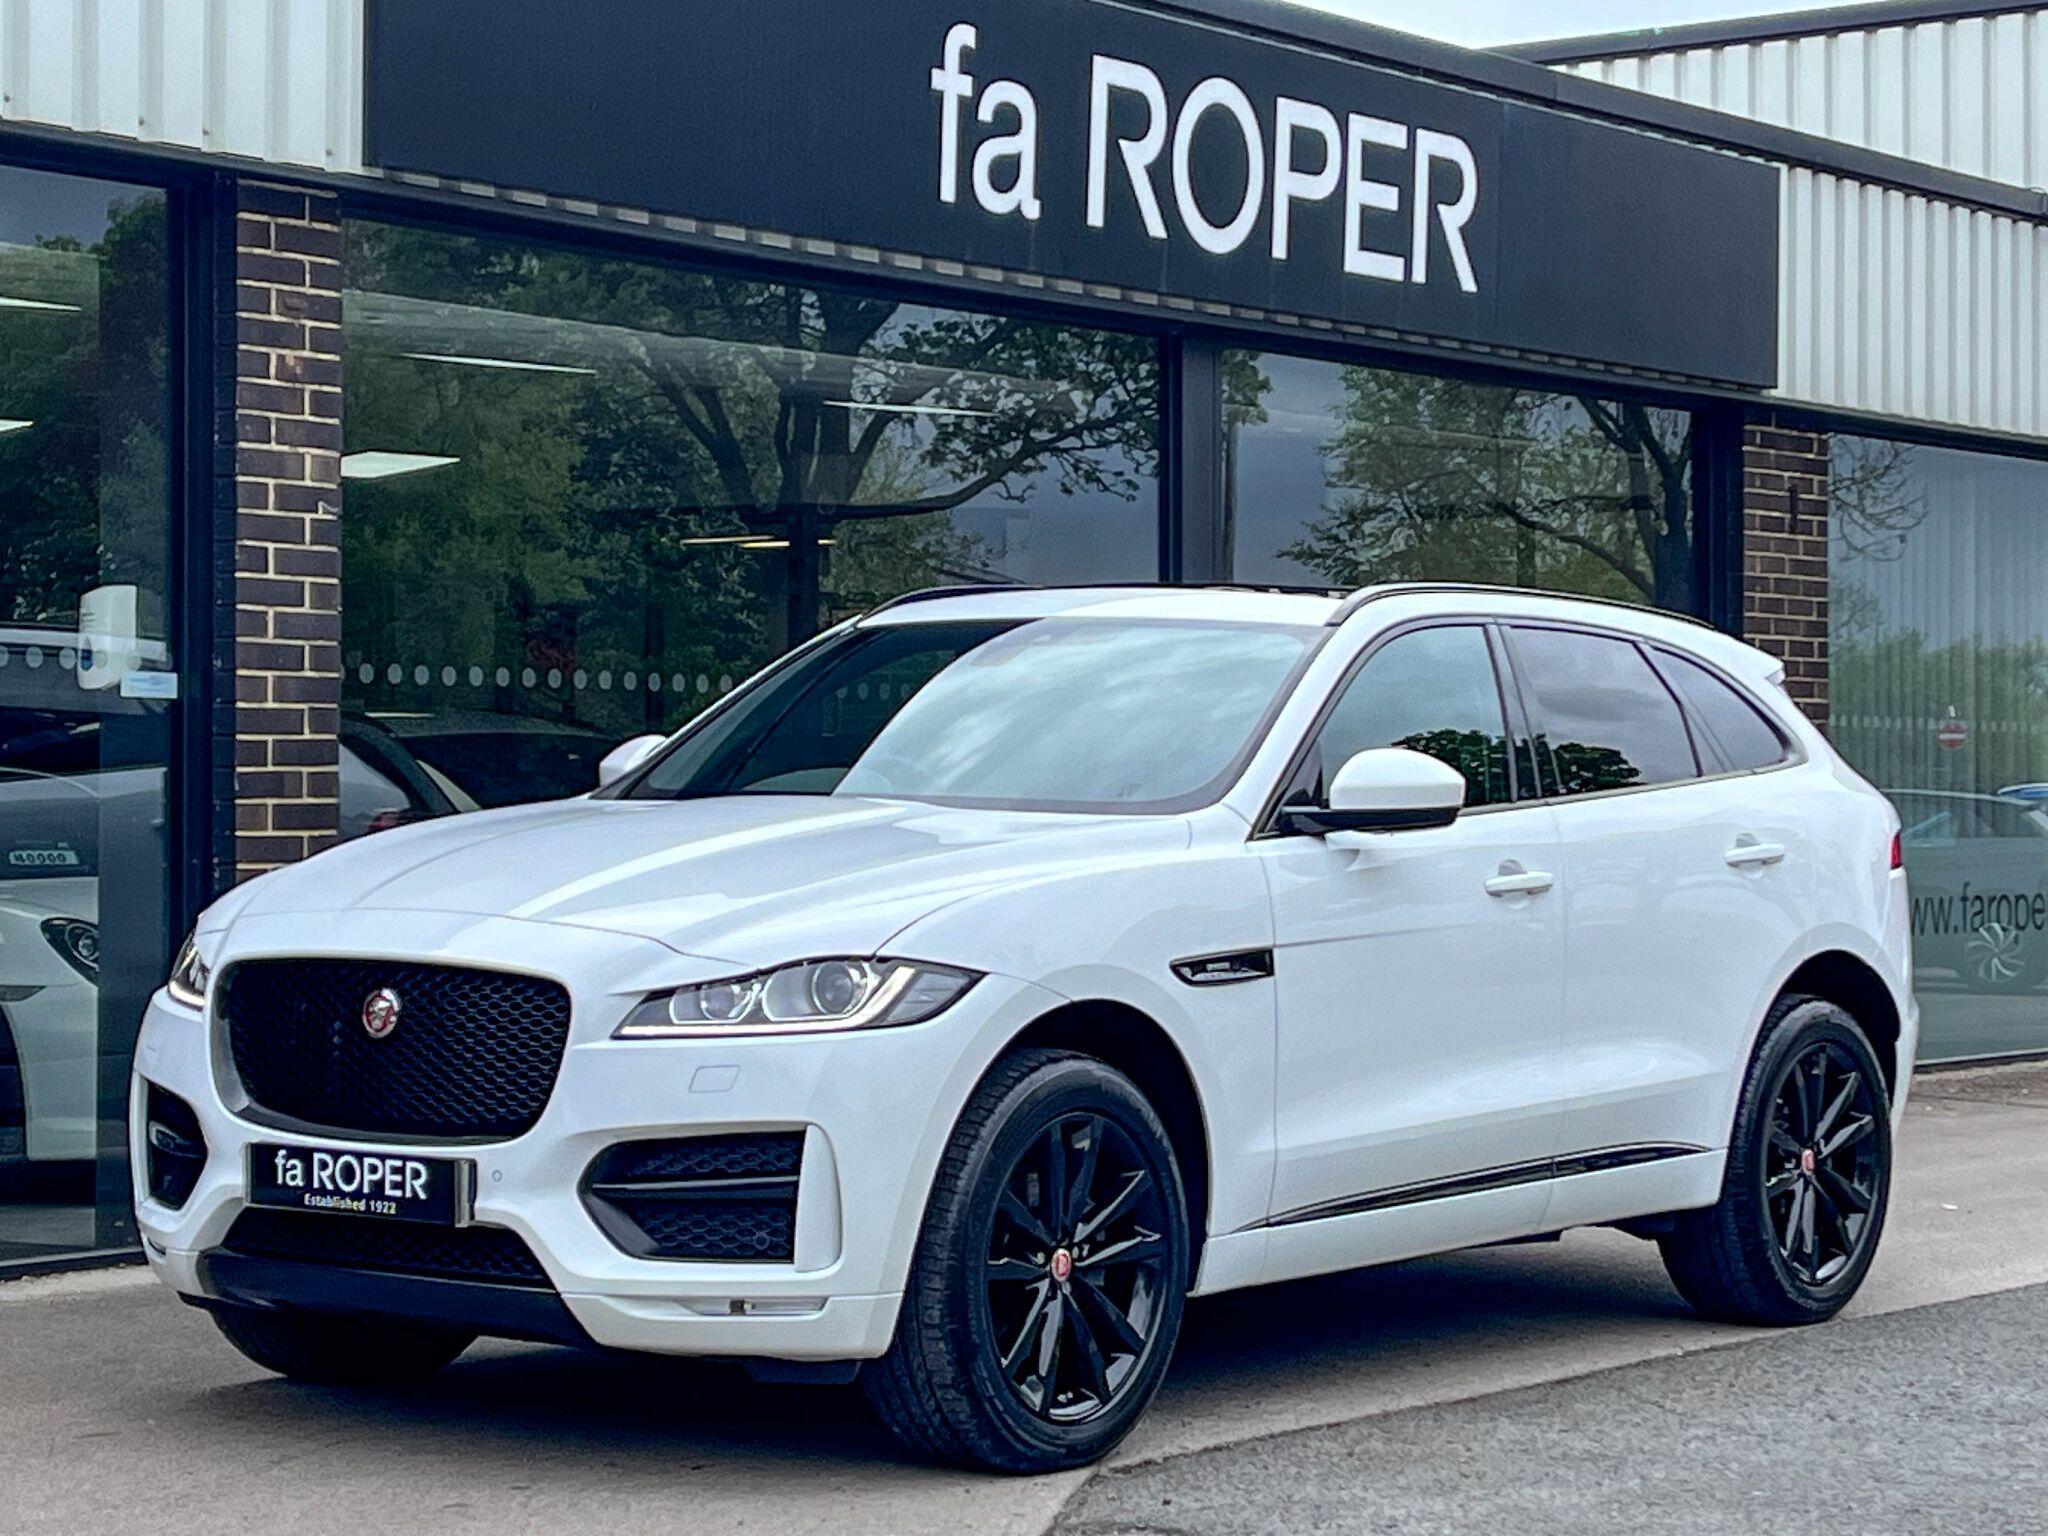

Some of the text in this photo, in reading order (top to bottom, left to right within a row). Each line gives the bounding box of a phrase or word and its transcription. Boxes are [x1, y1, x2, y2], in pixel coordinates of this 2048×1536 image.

[931, 24, 1478, 293] fa ROPER
[274, 1149, 429, 1200] fa ROPER
[303, 1193, 397, 1215] Established 1922
